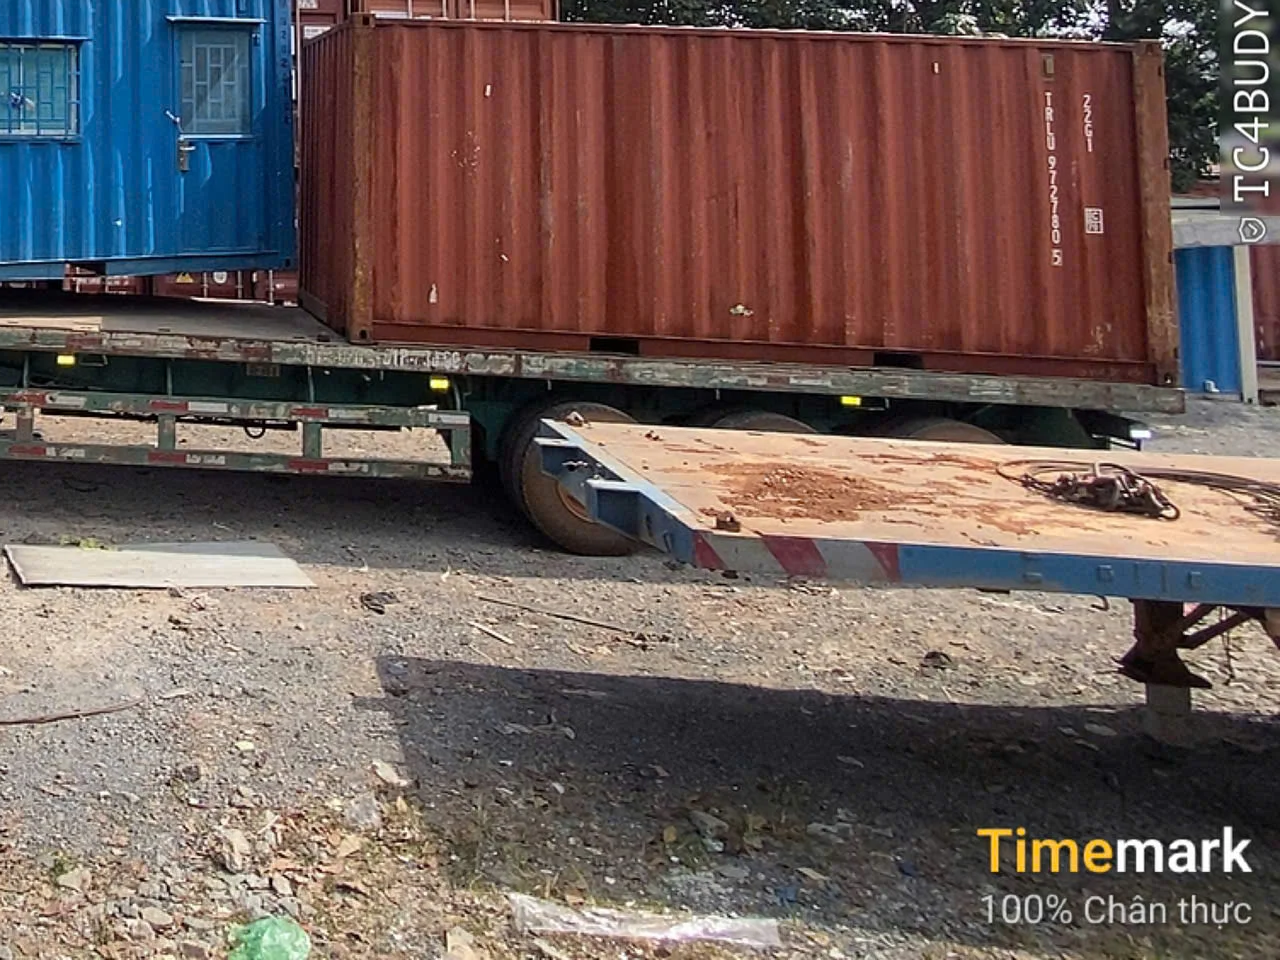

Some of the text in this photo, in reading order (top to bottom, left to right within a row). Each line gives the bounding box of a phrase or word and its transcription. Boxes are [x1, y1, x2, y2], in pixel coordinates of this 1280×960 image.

[1044, 92, 1056, 150] TRLU
[1083, 95, 1093, 153] 22G1
[1047, 155, 1061, 244] 972780
